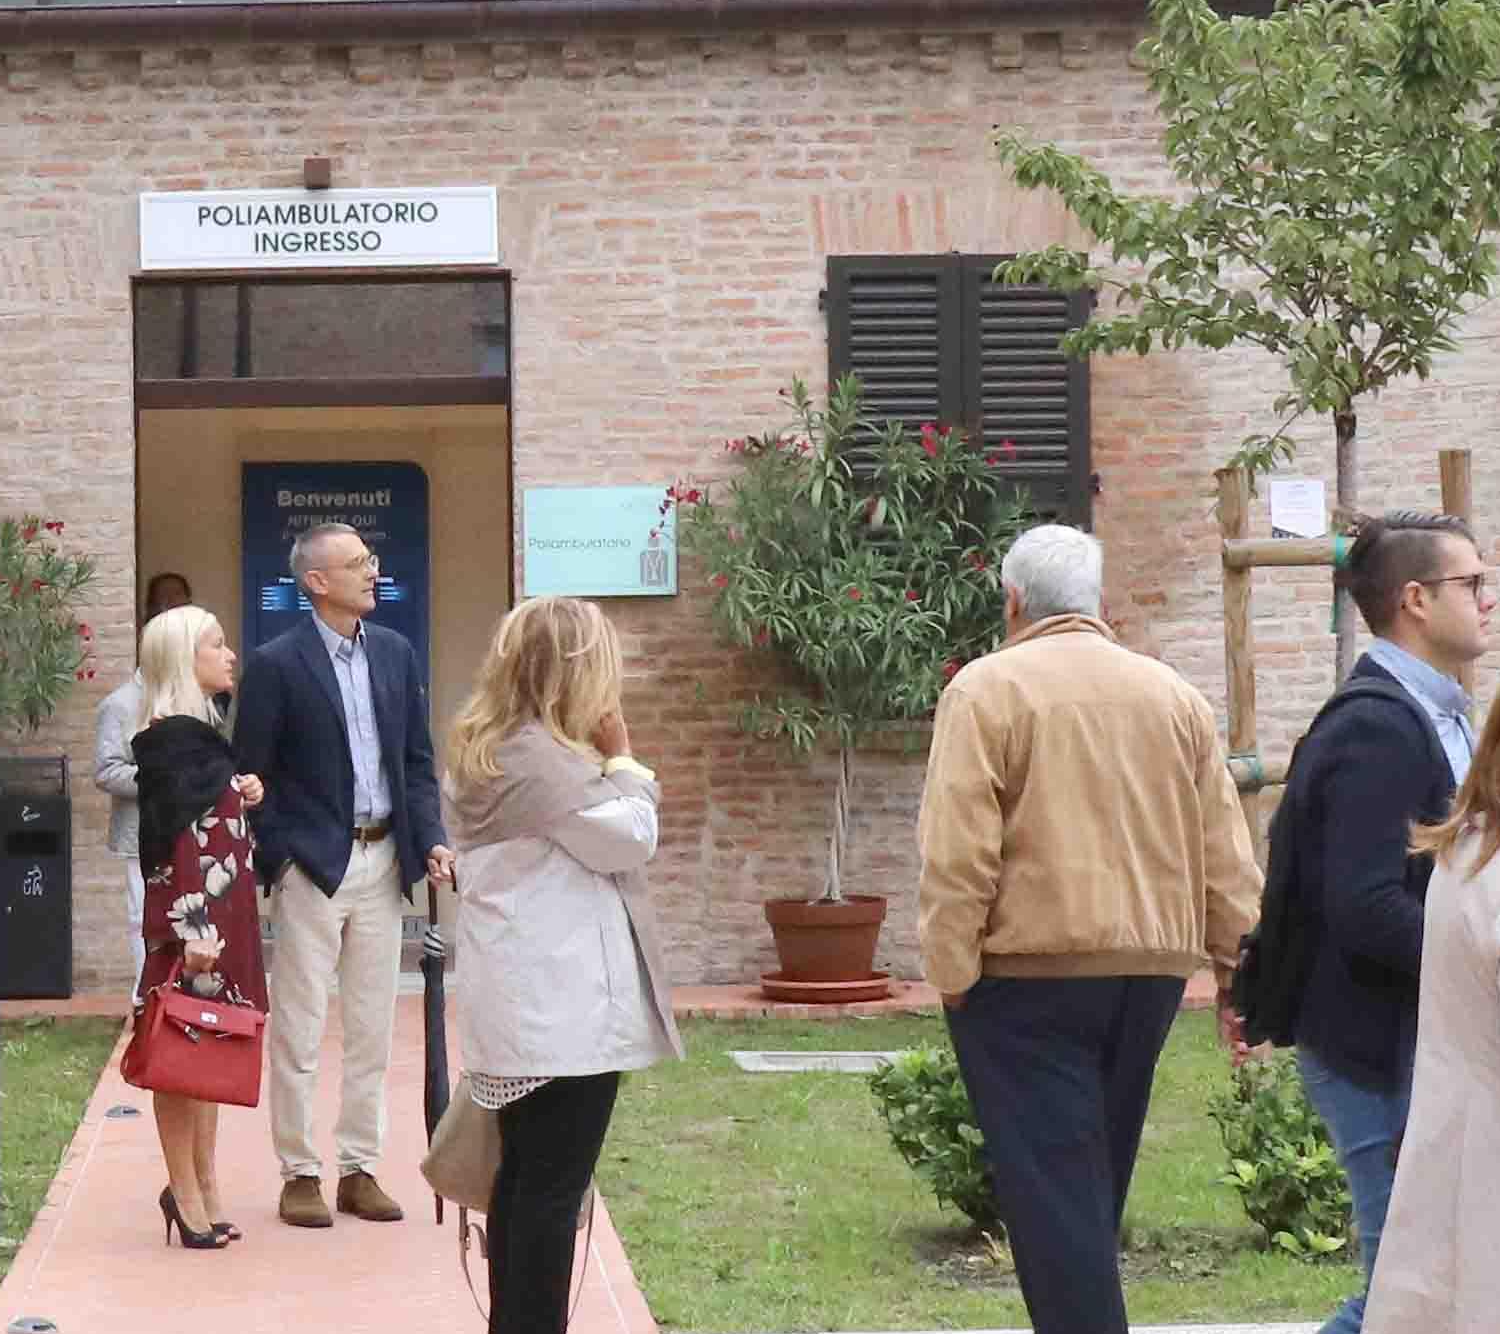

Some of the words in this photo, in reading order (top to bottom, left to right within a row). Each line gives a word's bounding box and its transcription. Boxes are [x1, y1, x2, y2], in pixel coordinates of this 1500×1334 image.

[197, 202, 439, 228] POLIAMBULATORIO
[254, 230, 383, 254] INGRESSO
[276, 488, 393, 509] Benvenuti
